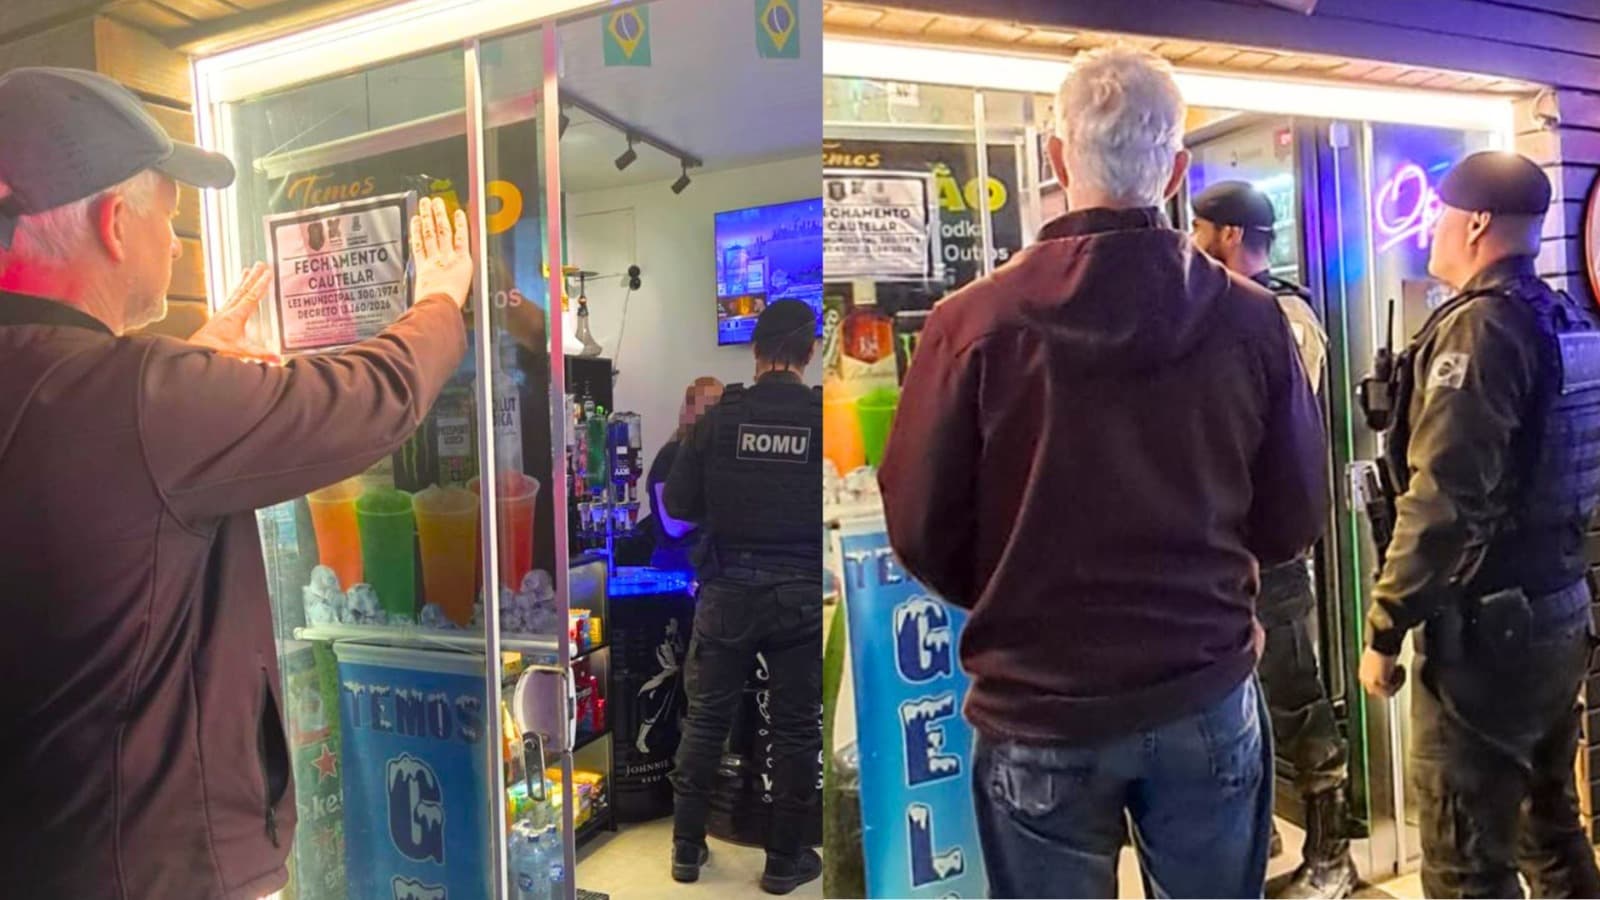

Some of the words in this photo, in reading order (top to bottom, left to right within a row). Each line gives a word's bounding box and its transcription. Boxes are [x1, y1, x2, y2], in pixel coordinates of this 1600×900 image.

[823, 151, 881, 168] emos
[828, 221, 897, 232] CAUTELAR
[295, 247, 389, 275] FECHAMENTO
[308, 269, 374, 290] CAUTELAR
[288, 298, 302, 309] LEI
[303, 293, 356, 307] MUNICIPAL
[297, 306, 338, 319] DECRETO
[741, 433, 807, 455] ROMU
[343, 680, 484, 745] TEMOS
